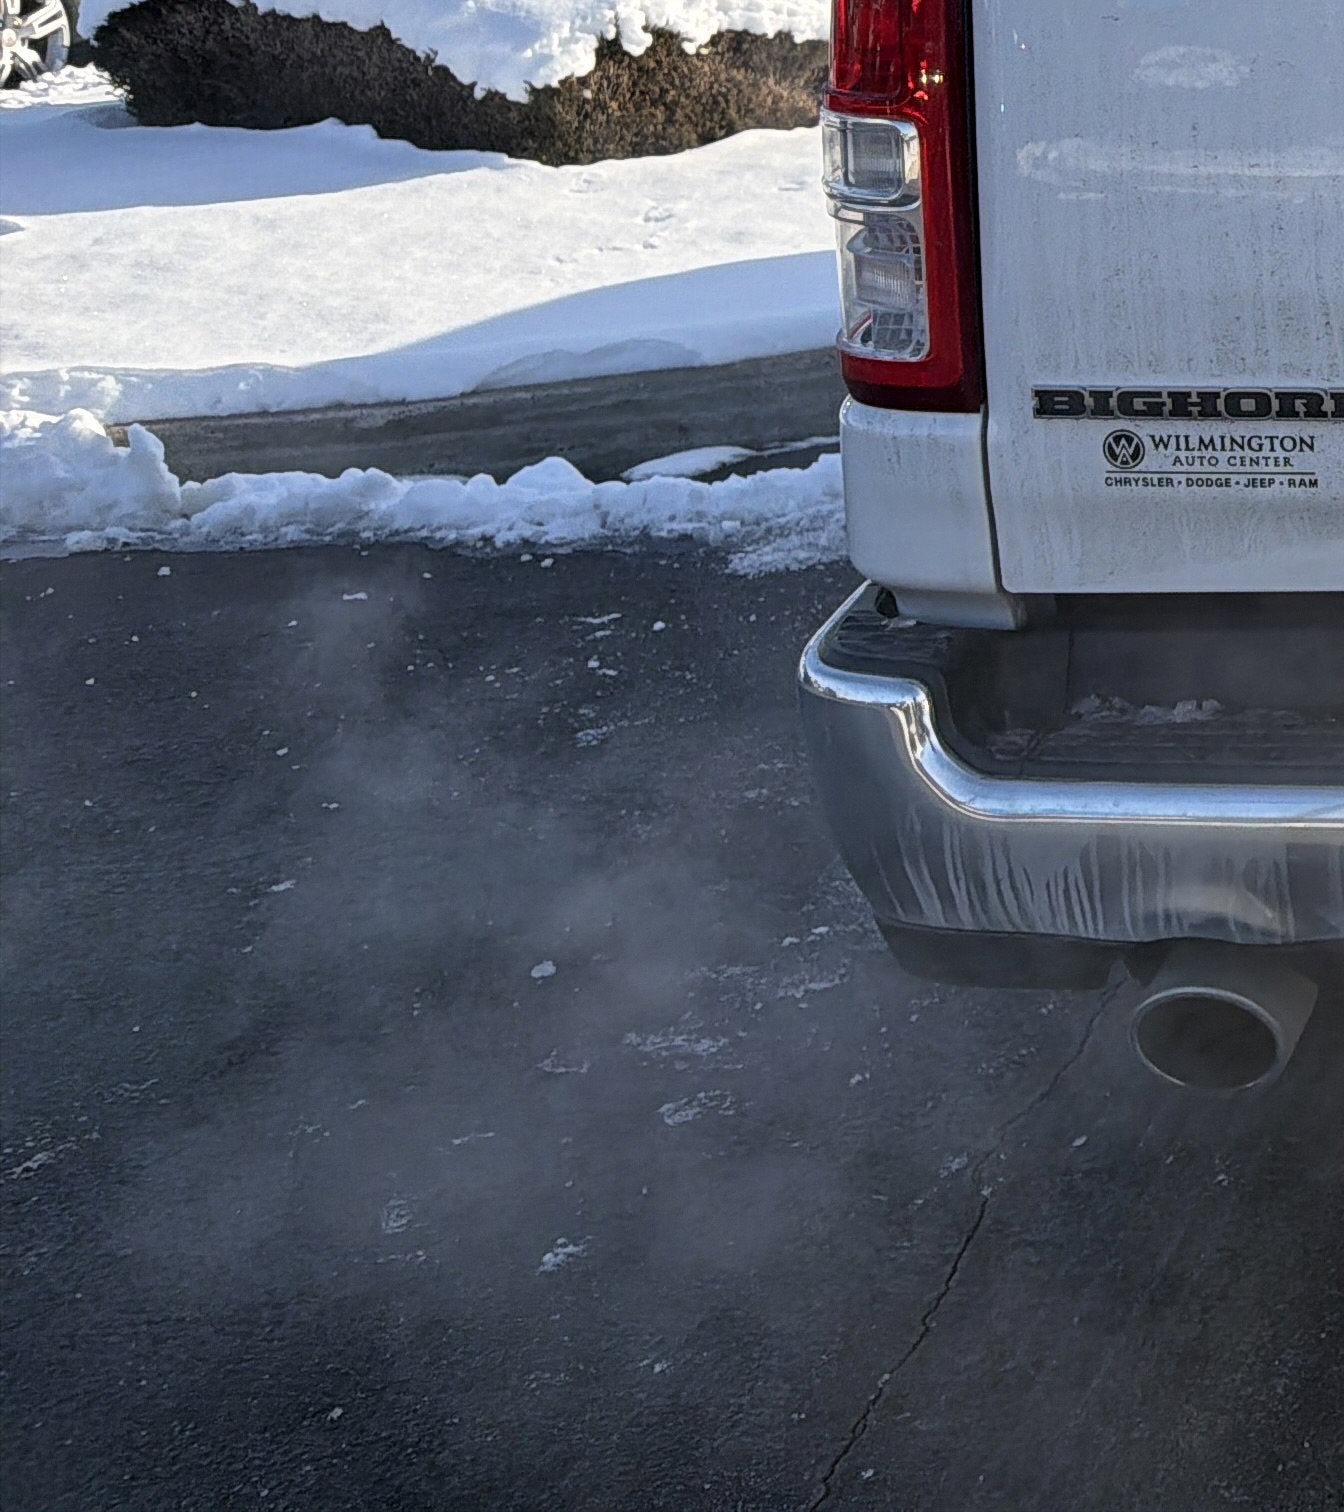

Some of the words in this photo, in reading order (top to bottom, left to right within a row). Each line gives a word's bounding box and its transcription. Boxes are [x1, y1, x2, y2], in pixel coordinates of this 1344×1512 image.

[1150, 433, 1316, 454] WILMINGTON
[1172, 455, 1220, 467] AUTO
[1227, 455, 1294, 468] CENTER
[1105, 476, 1174, 488] CHRYSLER
[1186, 477, 1232, 488] DODGE
[1243, 478, 1276, 488] JEEP
[1288, 478, 1319, 489] RAM
